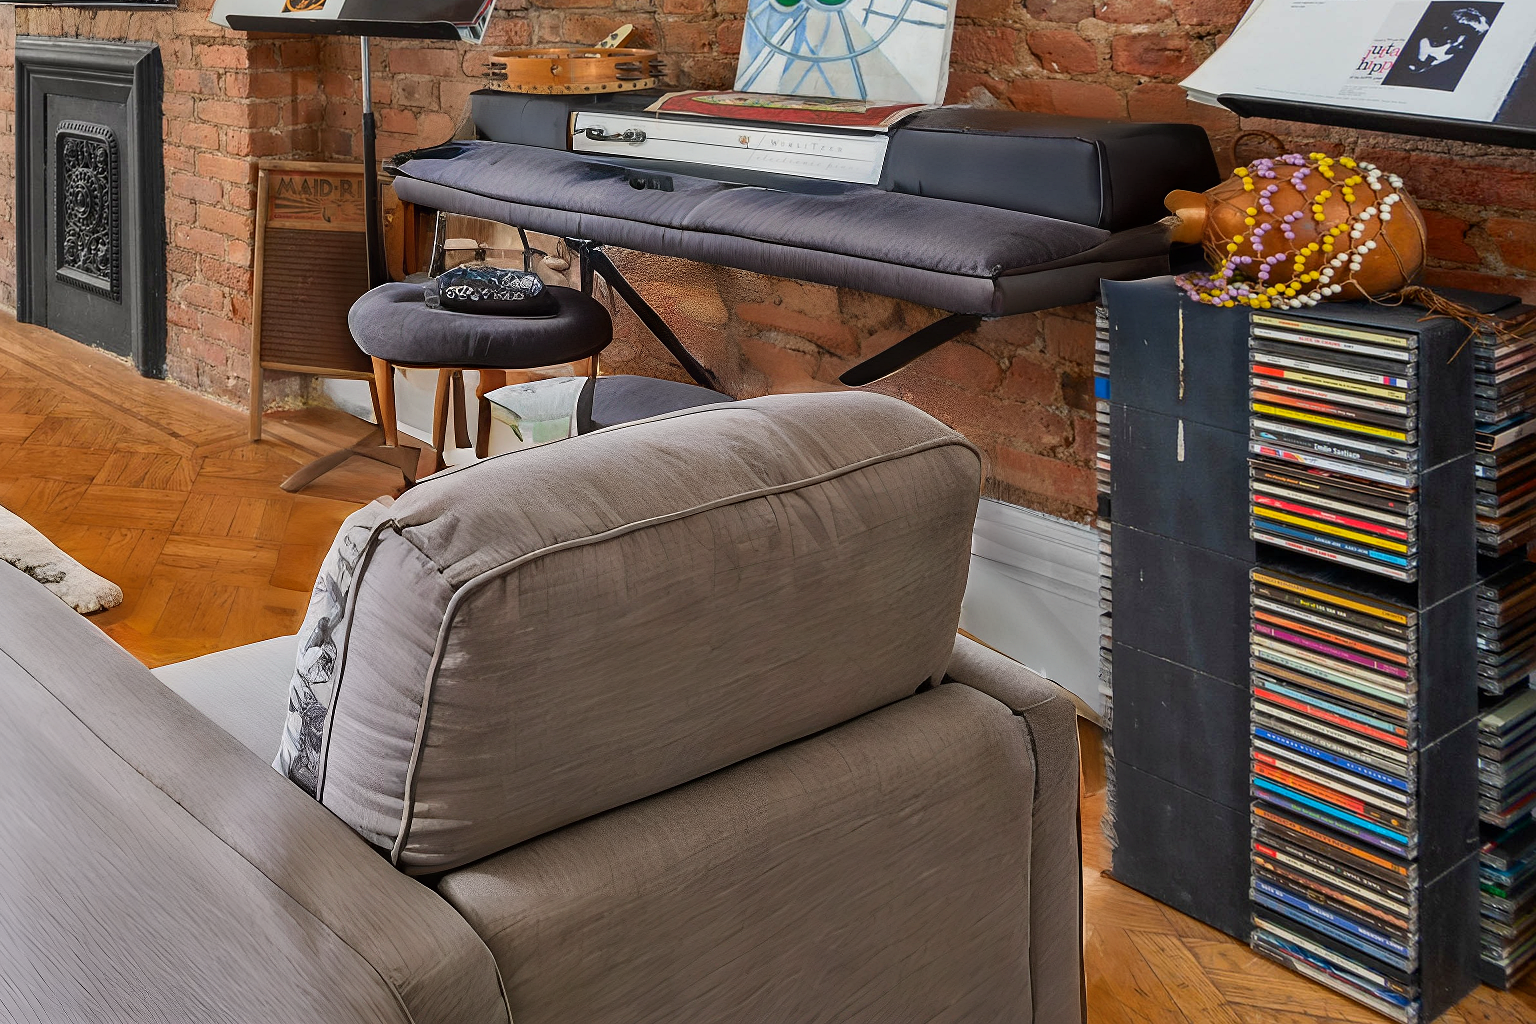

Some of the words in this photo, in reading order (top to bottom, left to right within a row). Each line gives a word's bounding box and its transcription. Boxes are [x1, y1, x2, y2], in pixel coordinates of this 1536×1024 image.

[276, 177, 363, 198] MAID-RI
[1314, 443, 1331, 452] Emilio
[1333, 447, 1360, 459] Santiago
[1290, 728, 1315, 741] HOME
[1324, 740, 1372, 763] SPEARHEAD
[1302, 807, 1319, 819] brand
[1343, 869, 1361, 882] THAT
[1362, 878, 1380, 890] TAKE
[1308, 904, 1333, 920] CONTROL
[1358, 926, 1383, 943] JACKSON
